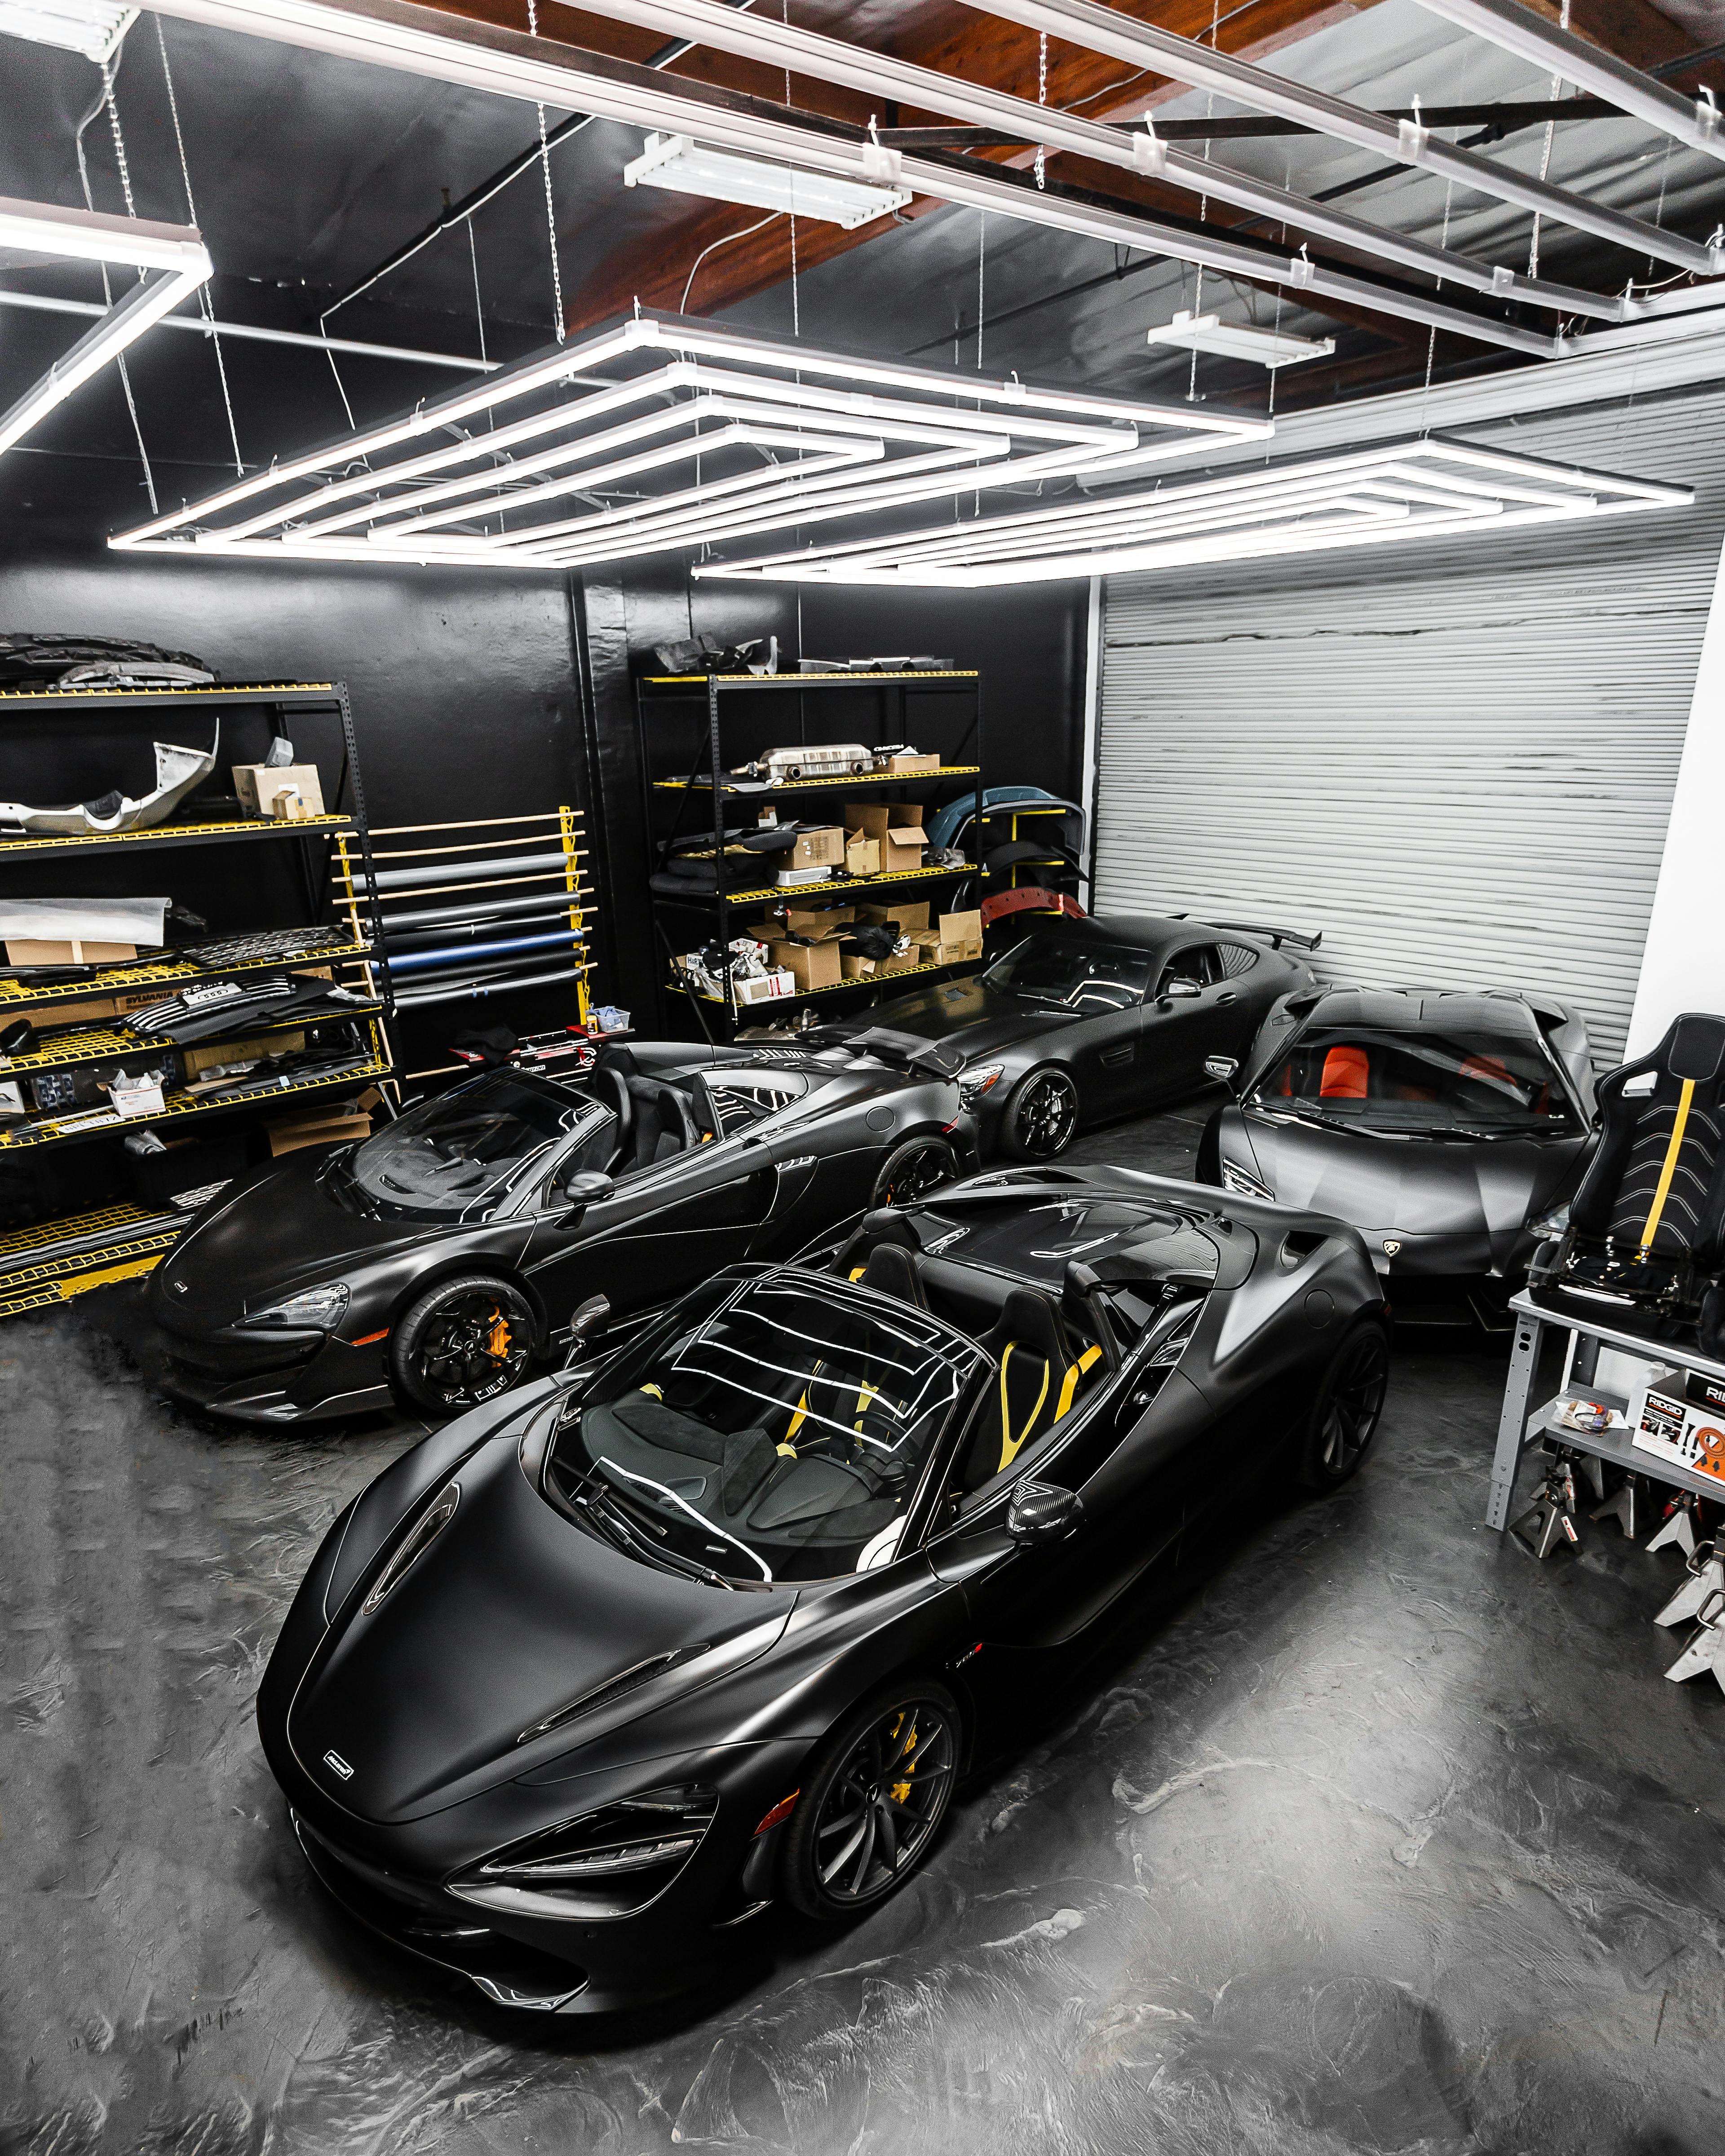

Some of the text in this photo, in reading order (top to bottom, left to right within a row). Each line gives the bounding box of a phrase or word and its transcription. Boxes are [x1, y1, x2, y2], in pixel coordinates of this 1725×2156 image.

[126, 991, 173, 1004] SYLVANIA
[1648, 1396, 1683, 1416] RIDGID
[327, 1755, 347, 1775] McLaren
